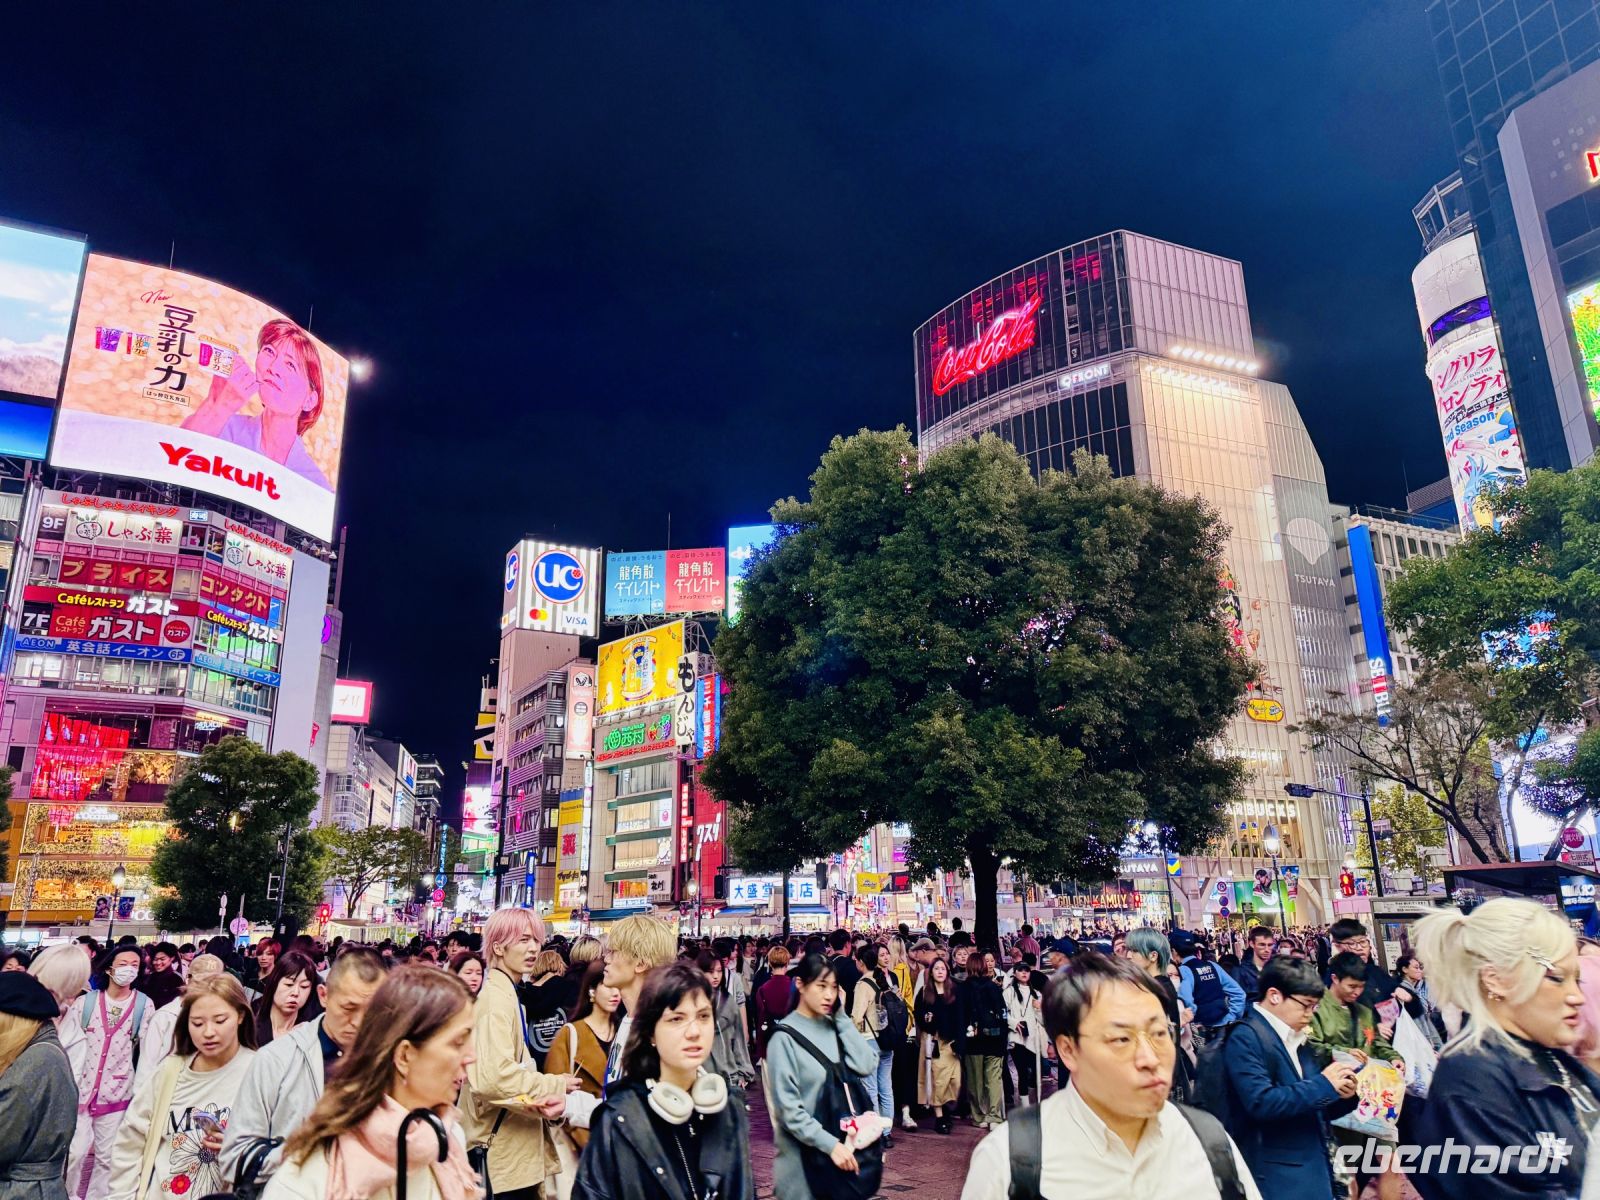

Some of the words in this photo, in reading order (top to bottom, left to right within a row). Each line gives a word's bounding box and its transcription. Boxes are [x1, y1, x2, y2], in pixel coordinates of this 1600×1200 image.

[141, 289, 174, 304] New
[150, 304, 197, 391] 豆乳の力
[1455, 411, 1495, 436] Season
[159, 441, 281, 500] Yakult
[61, 493, 180, 517] しゃぶしゃぶバイキング
[42, 517, 65, 529] 9F
[107, 521, 172, 544] しゃぶ葉
[63, 560, 169, 586] プライス
[247, 550, 287, 579] しゃぶ葉
[620, 564, 654, 580] 龍角散
[679, 561, 713, 577] 龍角散
[538, 561, 581, 591] UC
[673, 577, 721, 593] ダイレクト
[1294, 573, 1336, 588] TSUTAYA
[201, 576, 267, 612] コンタクト
[614, 580, 660, 596] ダイレクト
[126, 597, 179, 616] ガスト
[23, 613, 51, 628] 7F
[56, 615, 86, 627] Café
[87, 616, 155, 641] ガスト
[565, 616, 588, 625] VISA
[166, 629, 188, 637] ガスト
[248, 621, 278, 643] ガスト
[21, 637, 55, 648] AEON
[169, 650, 184, 659] 6F
[1369, 657, 1391, 716] SEIBU
[677, 656, 695, 741] もんじゃ
[622, 729, 644, 747] 西村
[1057, 894, 1090, 907] GOLDEN
[1091, 893, 1127, 907] KAMUY
